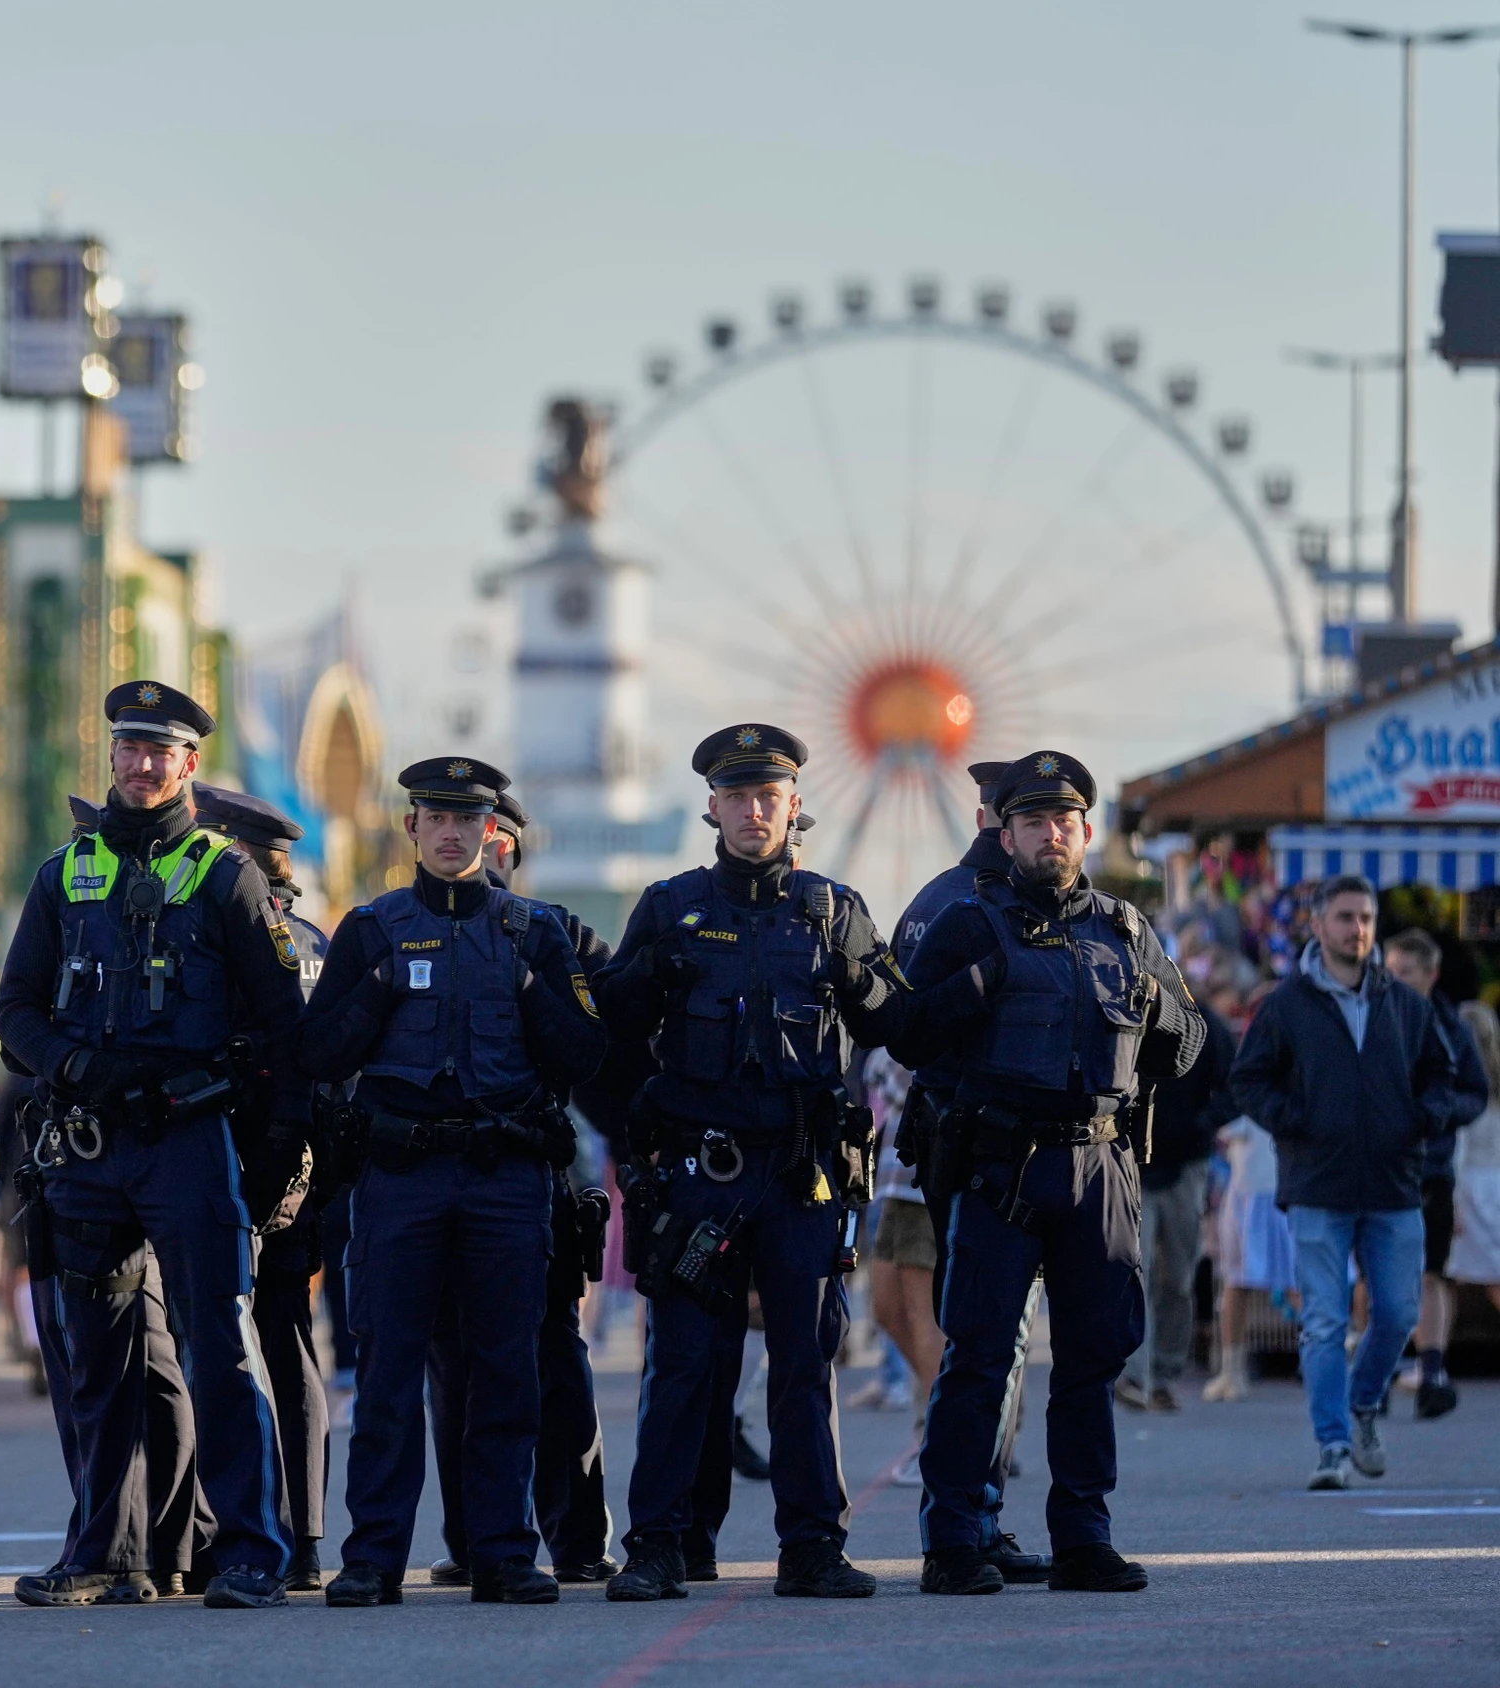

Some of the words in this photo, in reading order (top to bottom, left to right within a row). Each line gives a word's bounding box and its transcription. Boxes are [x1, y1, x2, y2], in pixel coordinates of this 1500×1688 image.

[72, 877, 102, 887] POLIZEI
[698, 930, 738, 941] POLIZEI
[904, 920, 930, 941] PO
[402, 939, 441, 949] POLIZEI
